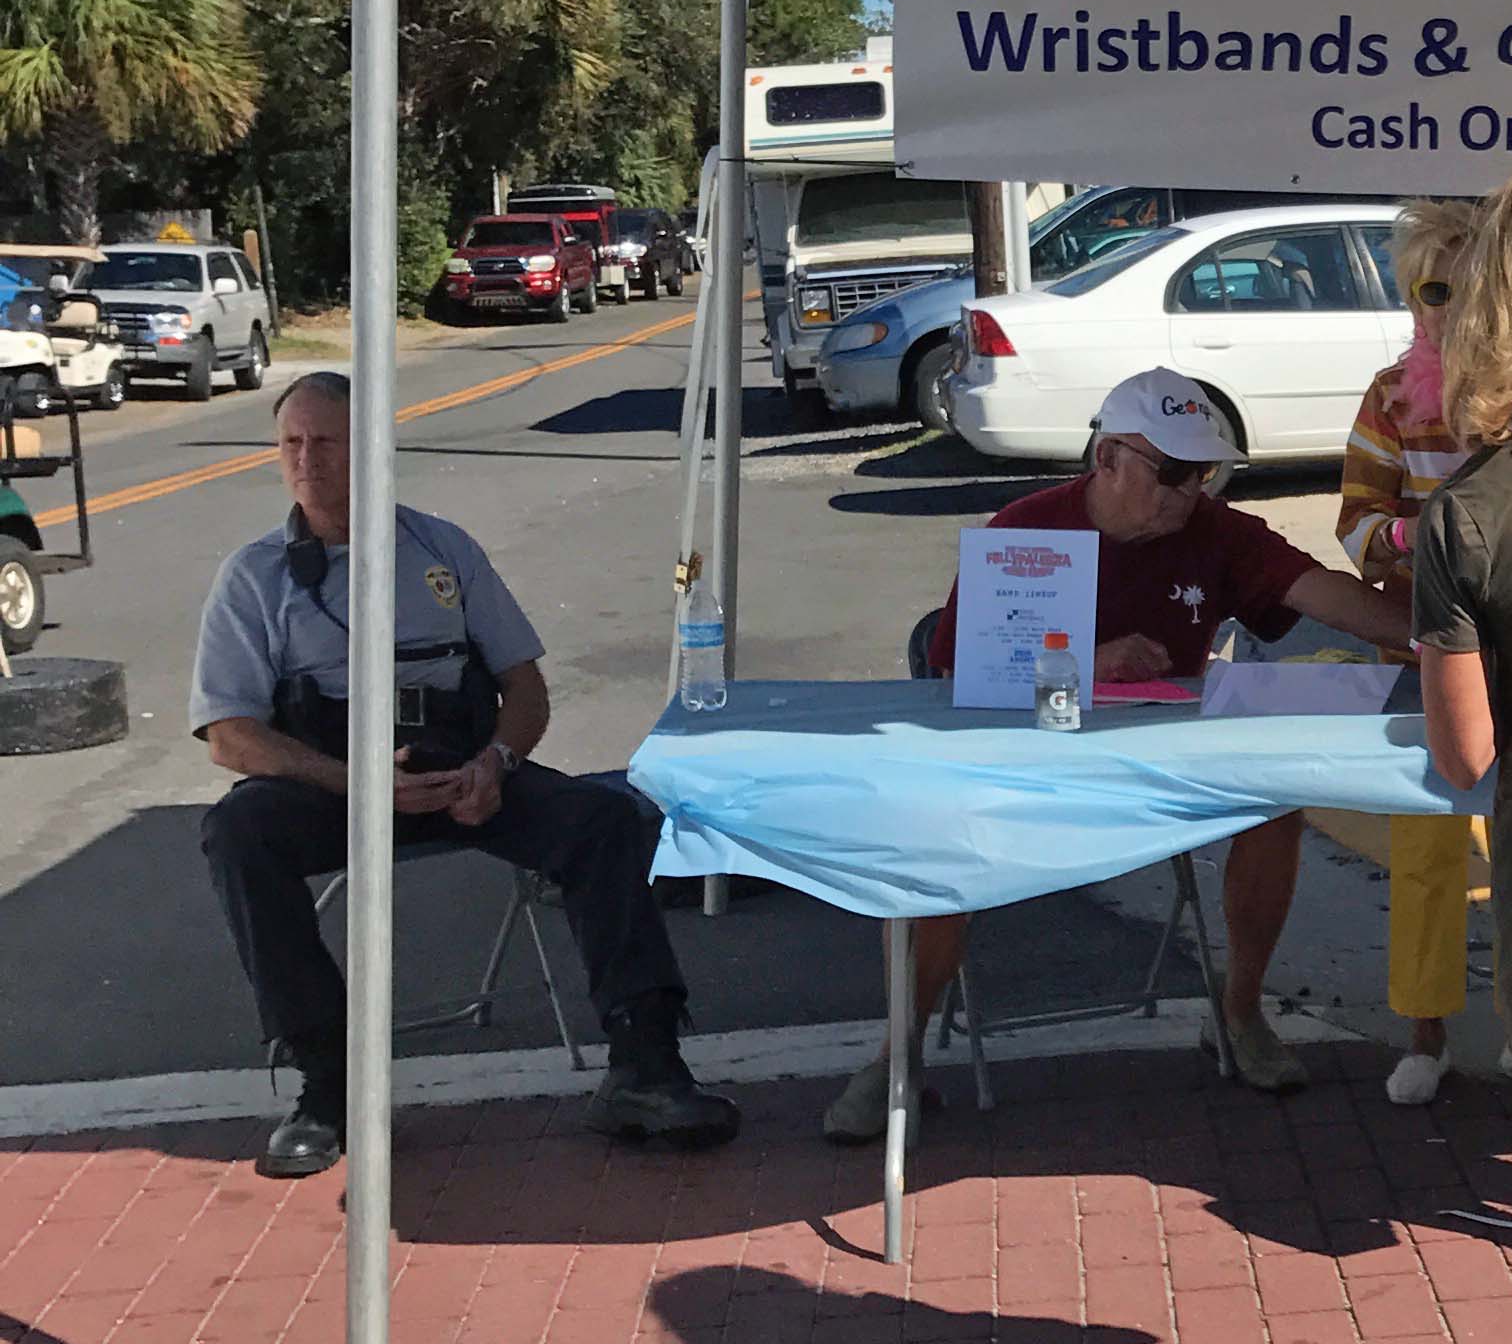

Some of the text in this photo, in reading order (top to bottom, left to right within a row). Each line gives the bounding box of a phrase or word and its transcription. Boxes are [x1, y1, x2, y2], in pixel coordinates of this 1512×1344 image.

[956, 10, 1389, 76] Wristbands
[1414, 17, 1471, 78] &
[1311, 102, 1439, 150] Cash
